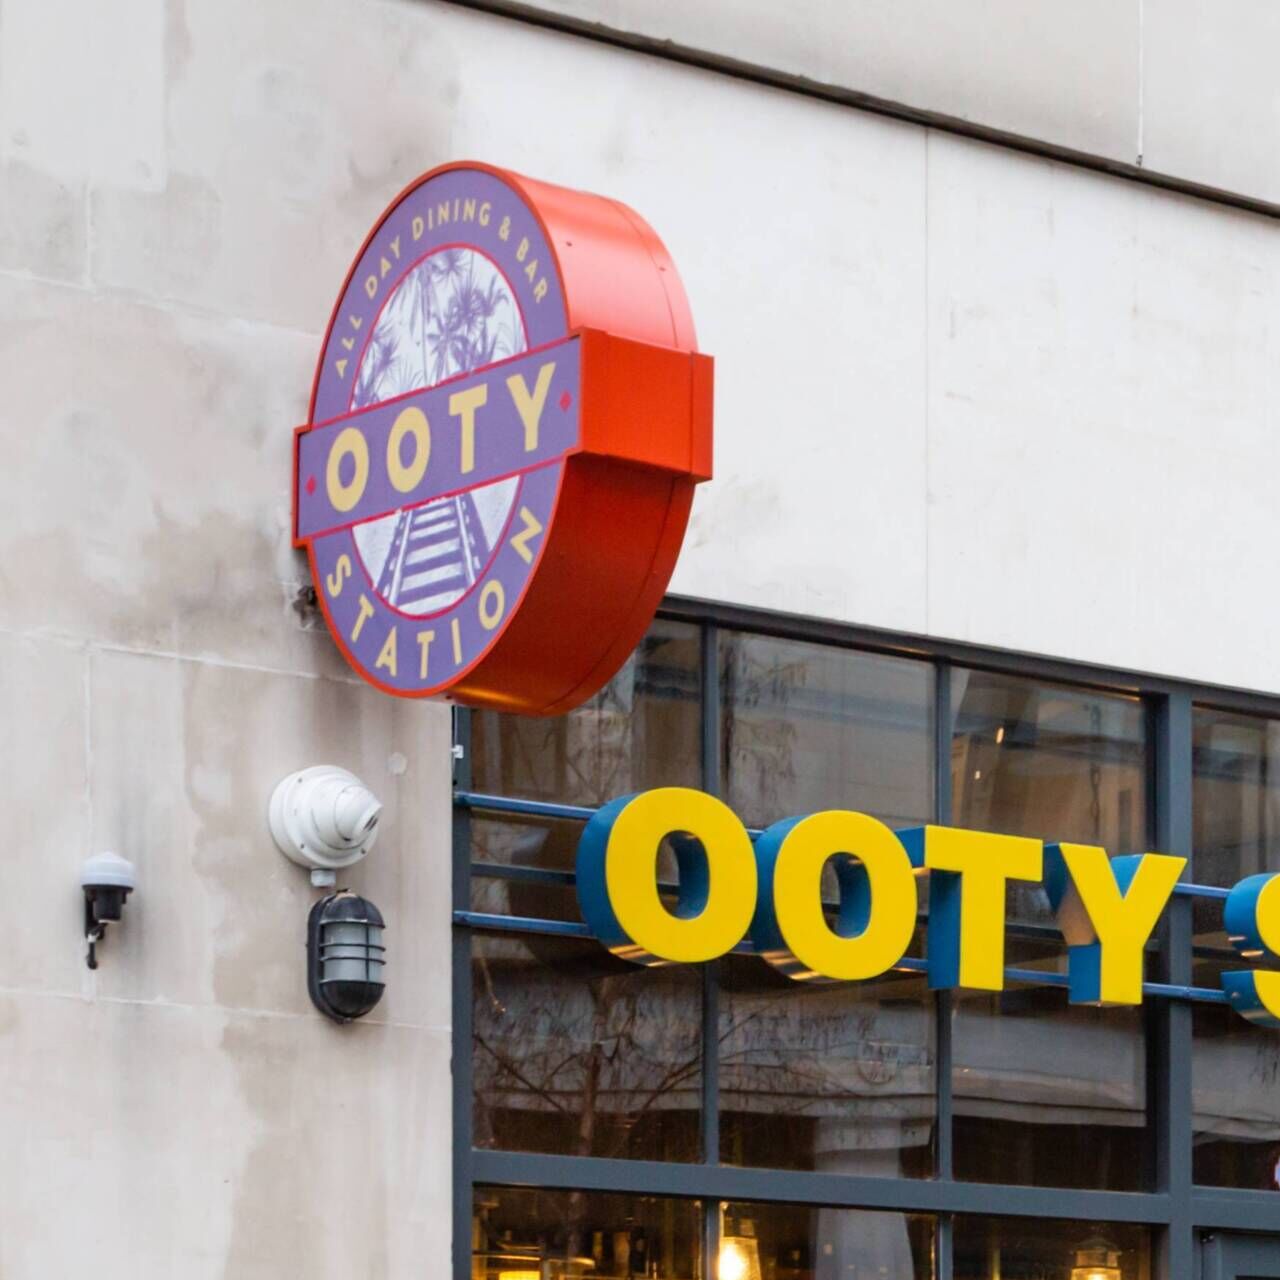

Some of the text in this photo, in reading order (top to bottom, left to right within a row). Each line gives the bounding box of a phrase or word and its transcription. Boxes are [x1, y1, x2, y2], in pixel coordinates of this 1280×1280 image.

[334, 198, 549, 378] ALL DAY DINING & BAR
[325, 361, 557, 513] OOTY
[325, 505, 545, 679] STATION
[604, 785, 1189, 1006] OOTY
